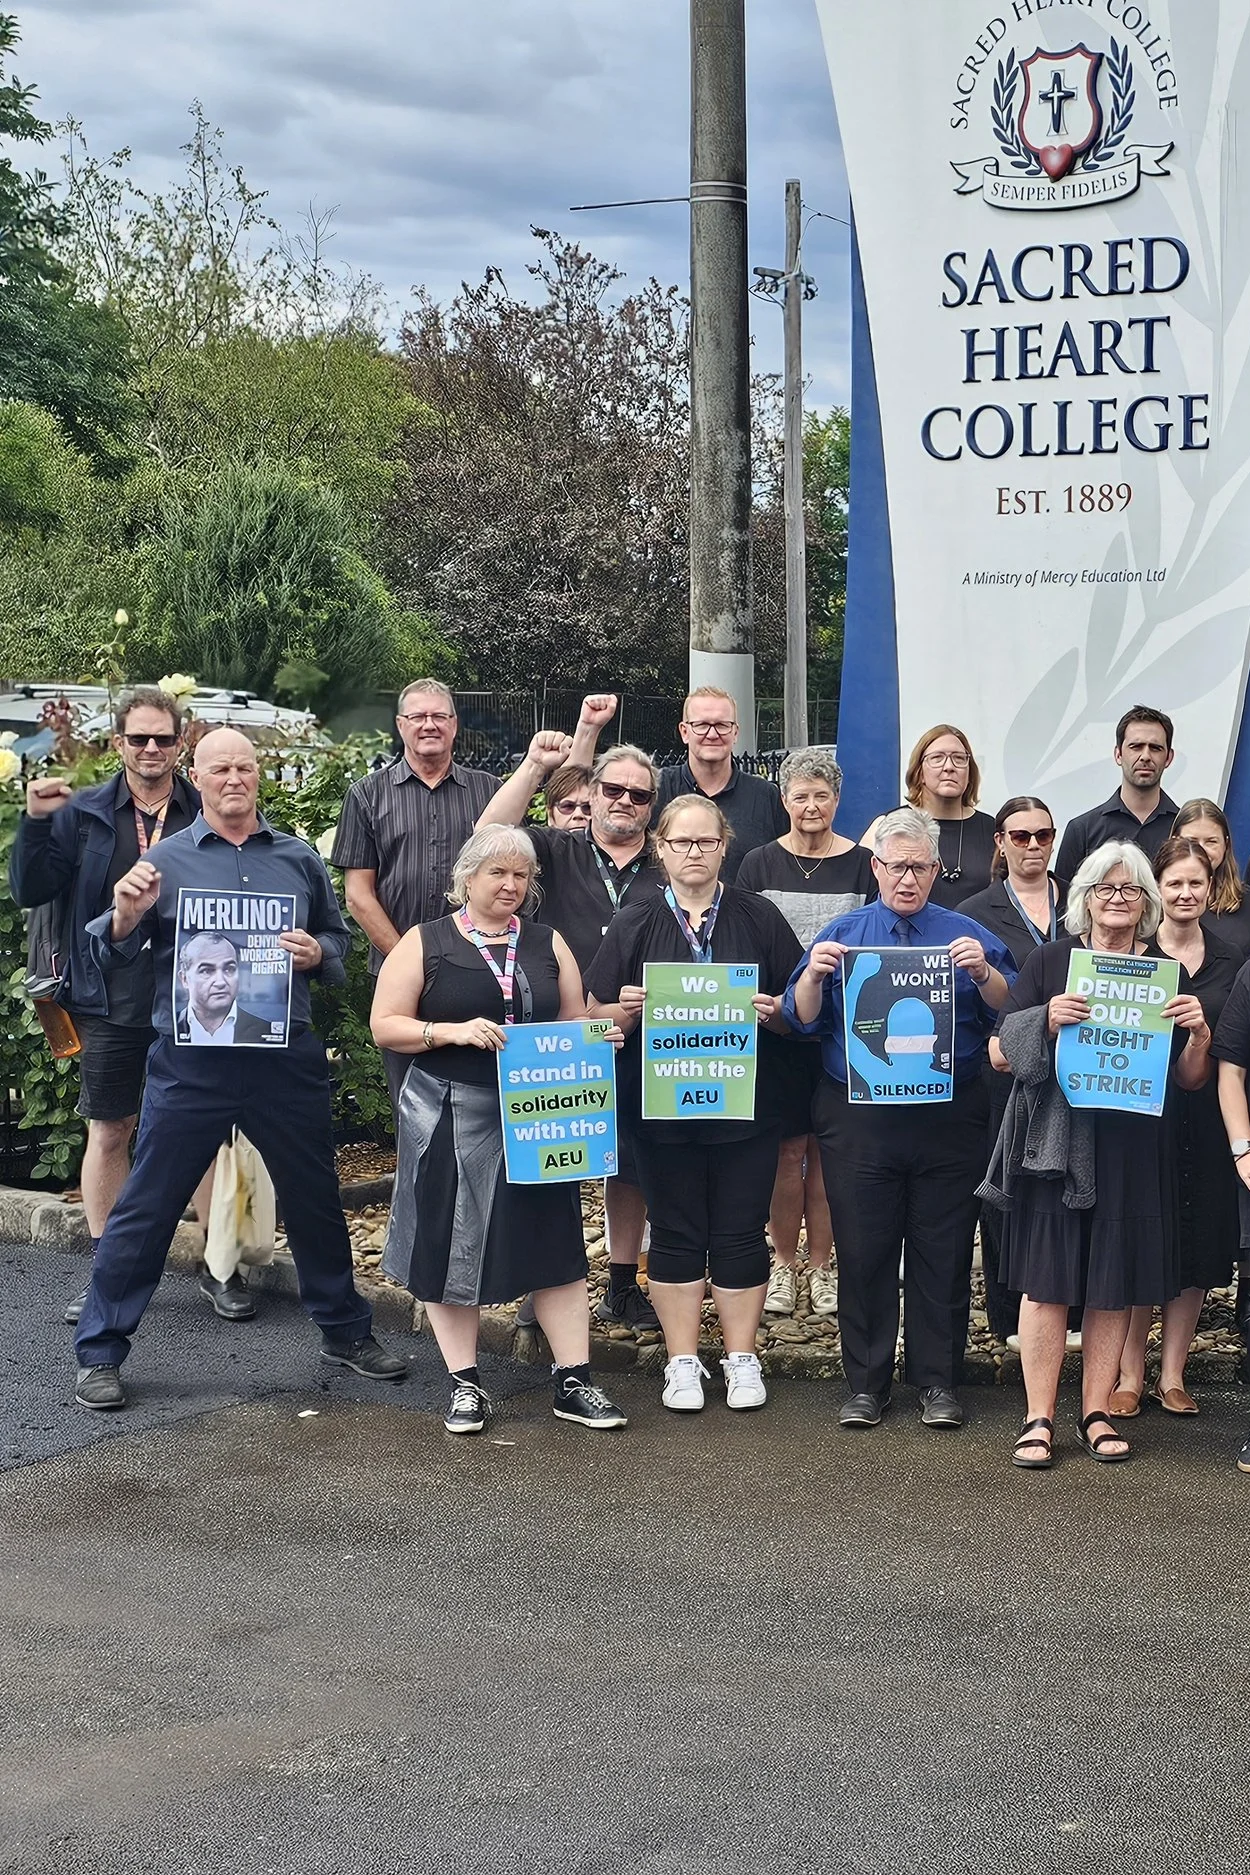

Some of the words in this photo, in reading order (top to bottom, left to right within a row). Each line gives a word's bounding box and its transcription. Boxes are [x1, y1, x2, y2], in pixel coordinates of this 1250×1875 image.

[950, 17, 1007, 130] SACRED
[1106, 0, 1178, 110] COLLEGE
[991, 181, 1057, 201] SEMPER
[1062, 171, 1128, 200] FIDELIS
[942, 236, 1190, 308] SACRED
[960, 316, 1171, 383] HEART
[920, 393, 1210, 461] COLLEGE
[1063, 483, 1133, 513] 1889
[962, 572, 971, 585] A
[974, 570, 1022, 588] Ministry
[1025, 569, 1039, 588] of
[1041, 570, 1078, 587] Mercy
[1081, 569, 1142, 583] Education
[1146, 568, 1167, 582] Ltd
[183, 897, 289, 931] MERLINO:
[247, 934, 281, 948] DENYIN
[240, 947, 285, 962] WORKERS
[923, 954, 949, 969] WE
[251, 960, 288, 975] RIGHTS!
[681, 976, 719, 994] We
[890, 972, 949, 987] WON'T
[930, 990, 949, 1003] BE
[1076, 976, 1167, 1005] DENIED
[652, 1004, 719, 1022] stand
[724, 1003, 745, 1022] in
[1089, 1003, 1143, 1027] OUR
[534, 1035, 573, 1053] We
[652, 1031, 749, 1051] solidarity
[1077, 1026, 1154, 1051] RIGHT
[653, 1058, 703, 1077] with
[707, 1060, 746, 1078] the
[1096, 1051, 1129, 1071] TO
[508, 1062, 576, 1084] stand
[580, 1060, 603, 1079] in
[873, 1082, 950, 1096] SILENCED!
[1067, 1072, 1153, 1097] STRIKE
[510, 1089, 608, 1114] solidarity
[681, 1090, 719, 1106] AEU
[513, 1121, 566, 1142] with
[569, 1119, 608, 1136] the
[544, 1149, 583, 1169] AEU
